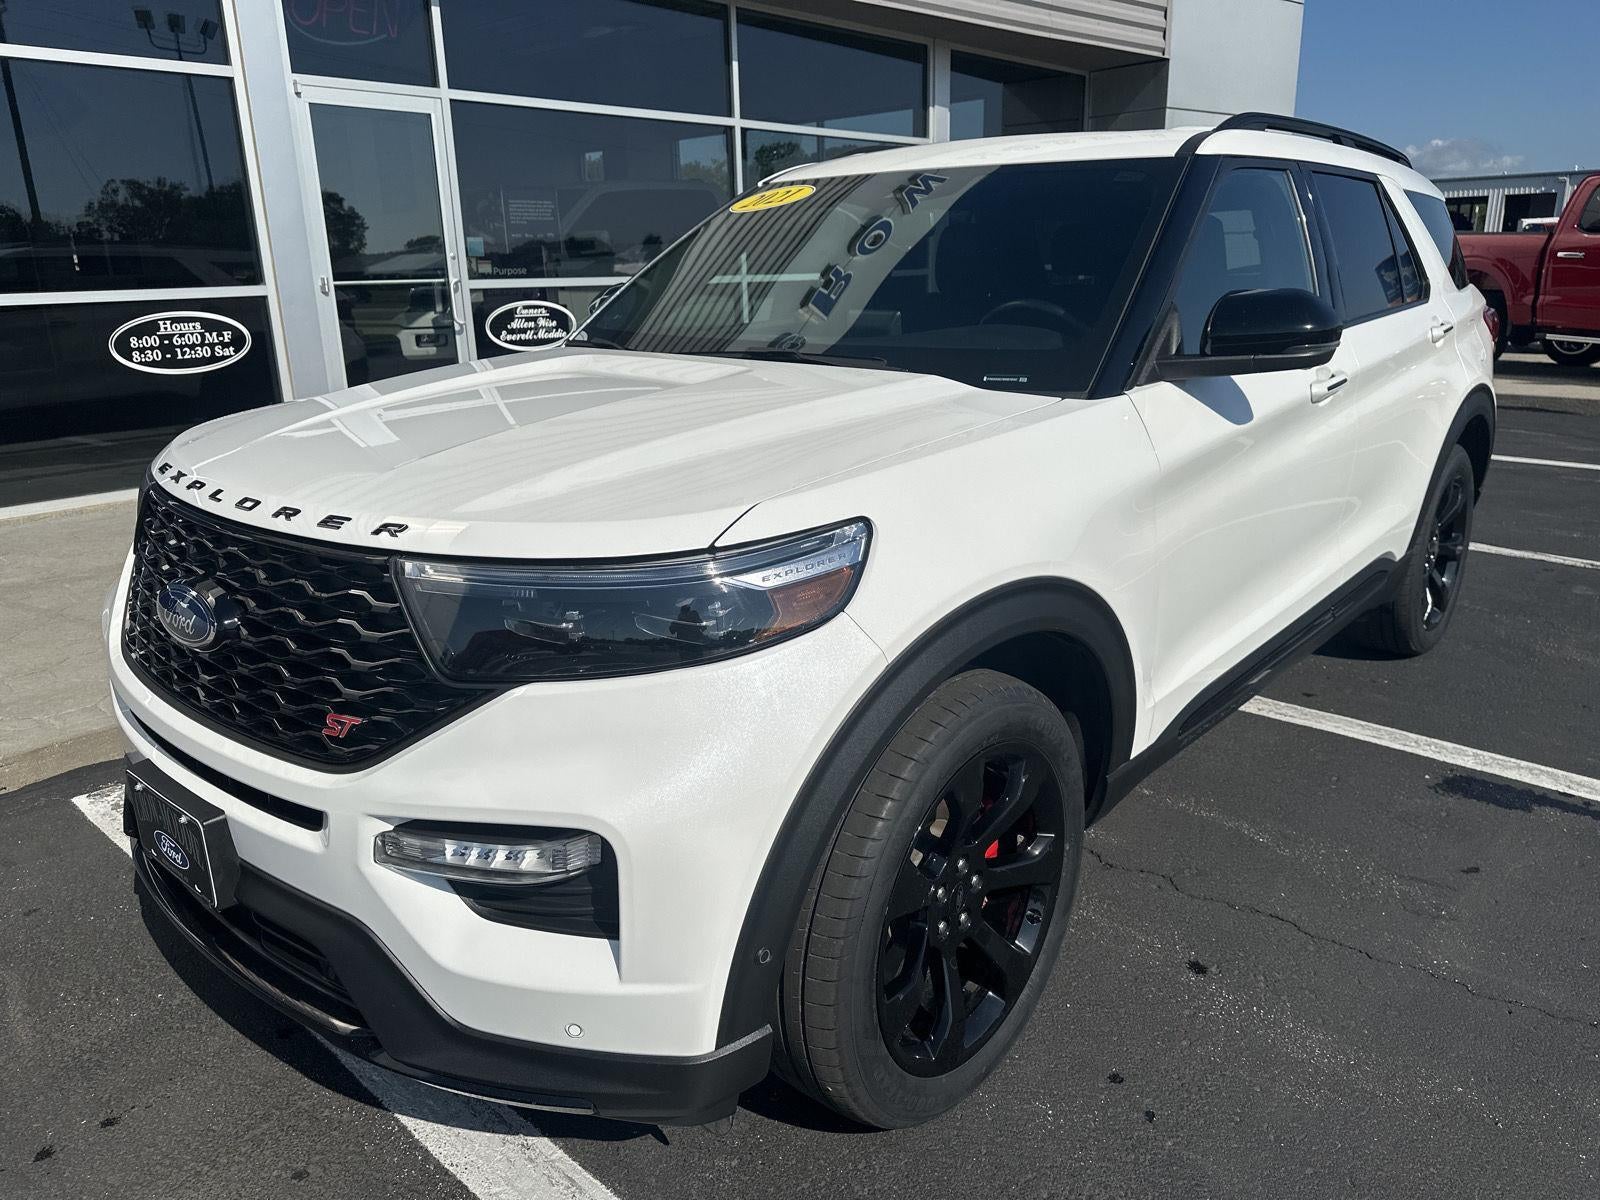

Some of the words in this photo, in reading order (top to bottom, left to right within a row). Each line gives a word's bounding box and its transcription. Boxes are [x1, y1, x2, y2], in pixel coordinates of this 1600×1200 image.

[738, 188, 806, 209] 2021
[493, 266, 528, 275] Purpose
[158, 320, 202, 332] Hours
[507, 318, 535, 329] Allen
[536, 317, 558, 328] Wise
[129, 335, 160, 348] 8:00
[172, 333, 201, 346] 6:00
[204, 331, 232, 344] M-F
[533, 328, 567, 340] Moddie
[132, 350, 162, 363] 8:30
[176, 346, 212, 360] 12:30
[214, 345, 236, 357] Sat
[158, 462, 409, 538] EXPLORER
[761, 553, 847, 582] EXPLORER
[163, 593, 196, 635] Ford
[322, 713, 363, 738] ST
[161, 835, 184, 866] Ford
